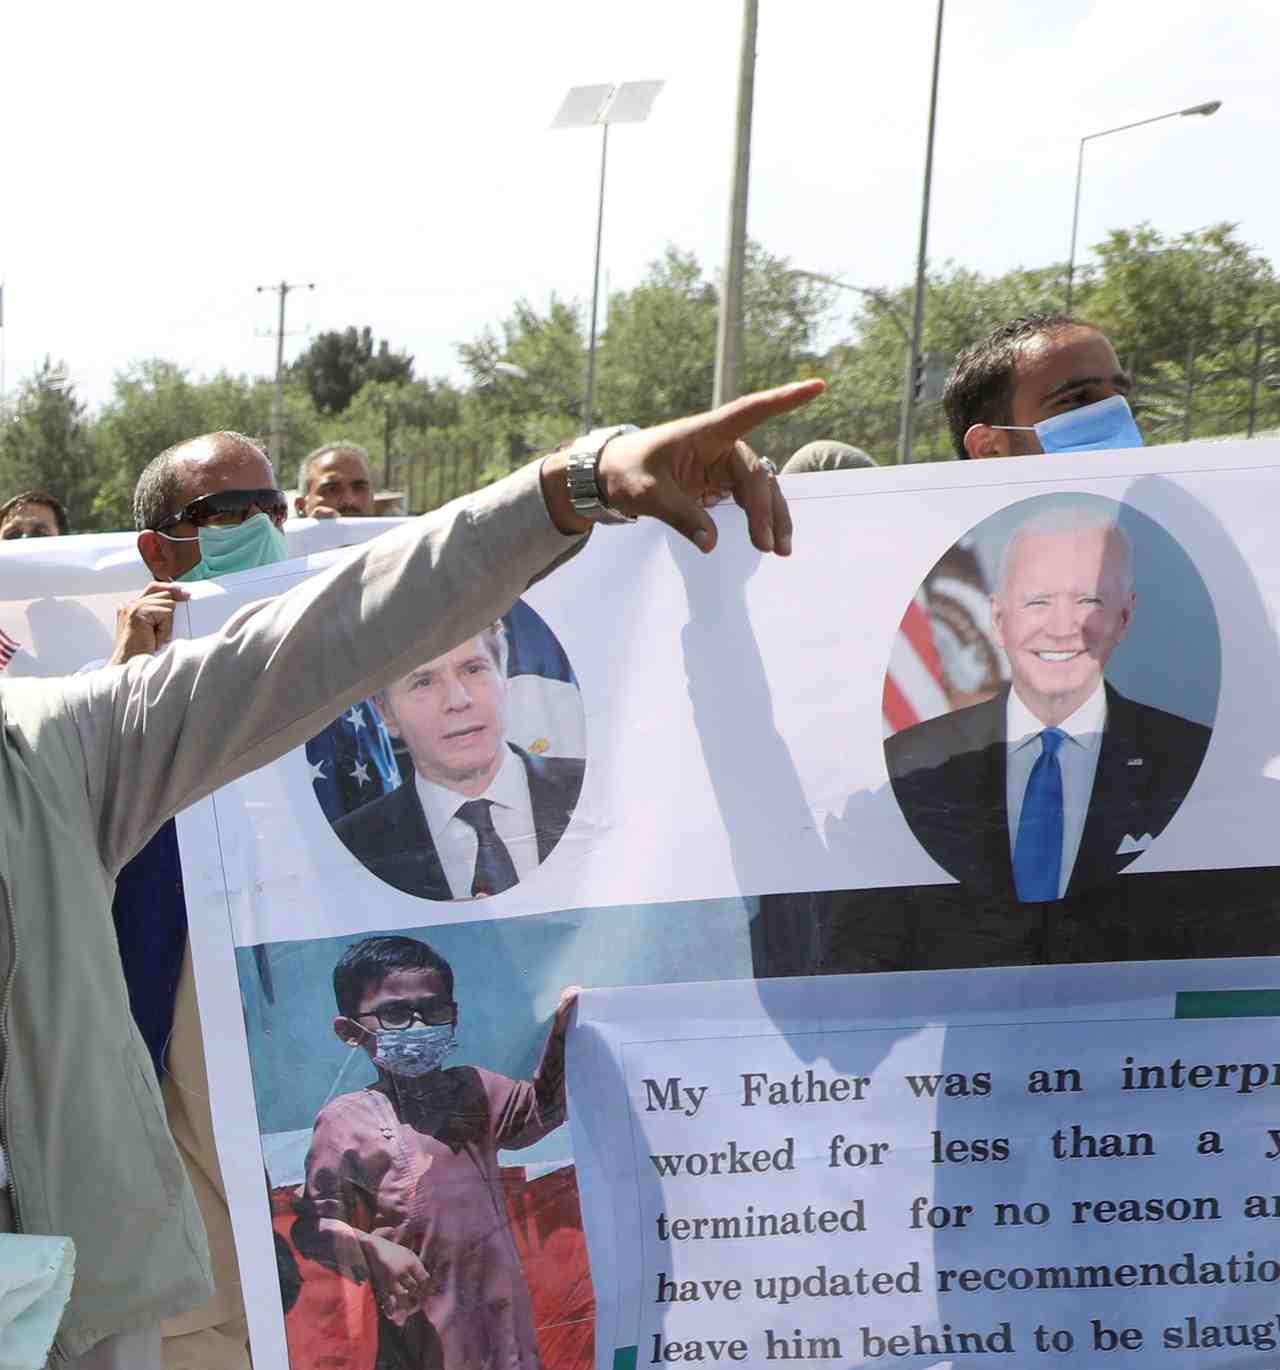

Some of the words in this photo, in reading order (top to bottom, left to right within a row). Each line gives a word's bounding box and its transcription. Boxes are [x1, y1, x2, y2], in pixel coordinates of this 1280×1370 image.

[641, 1077, 709, 1117] My
[740, 1070, 871, 1106] Father
[904, 1072, 992, 1100] was
[1028, 1069, 1083, 1093] an
[649, 1137, 795, 1177] worked
[828, 1134, 889, 1168] for
[931, 1130, 1010, 1163] less
[1051, 1125, 1156, 1159] than
[1197, 1131, 1224, 1154] a
[656, 1199, 867, 1241] terminated
[909, 1197, 973, 1229] for
[994, 1203, 1050, 1226] no
[1072, 1198, 1222, 1224] reason
[656, 1272, 742, 1303] have
[754, 1261, 922, 1304] updated
[650, 1333, 748, 1363] leave
[764, 1329, 843, 1360] him
[860, 1322, 1015, 1358] behind
[1034, 1325, 1073, 1352] to
[1090, 1320, 1143, 1351] be
[1163, 1314, 1280, 1352] slaug
